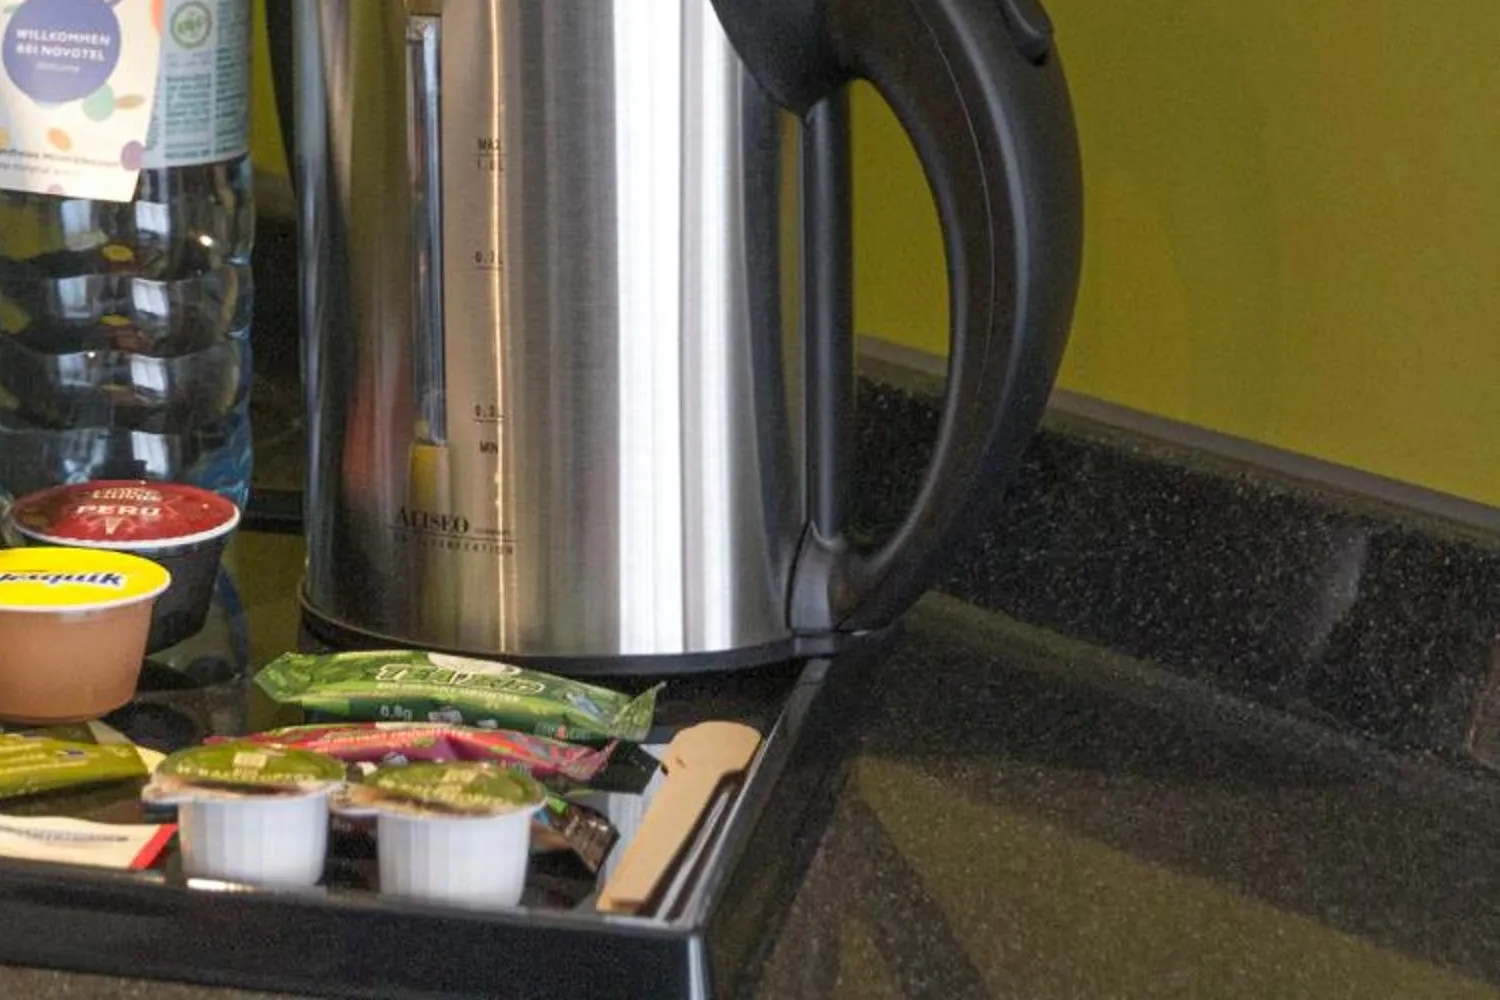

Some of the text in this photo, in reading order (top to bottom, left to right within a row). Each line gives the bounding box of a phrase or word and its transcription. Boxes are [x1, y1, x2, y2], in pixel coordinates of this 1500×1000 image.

[16, 29, 111, 45] WILLKOMMEN
[16, 43, 105, 61] BEI NOVOTEL
[76, 504, 163, 517] PERU
